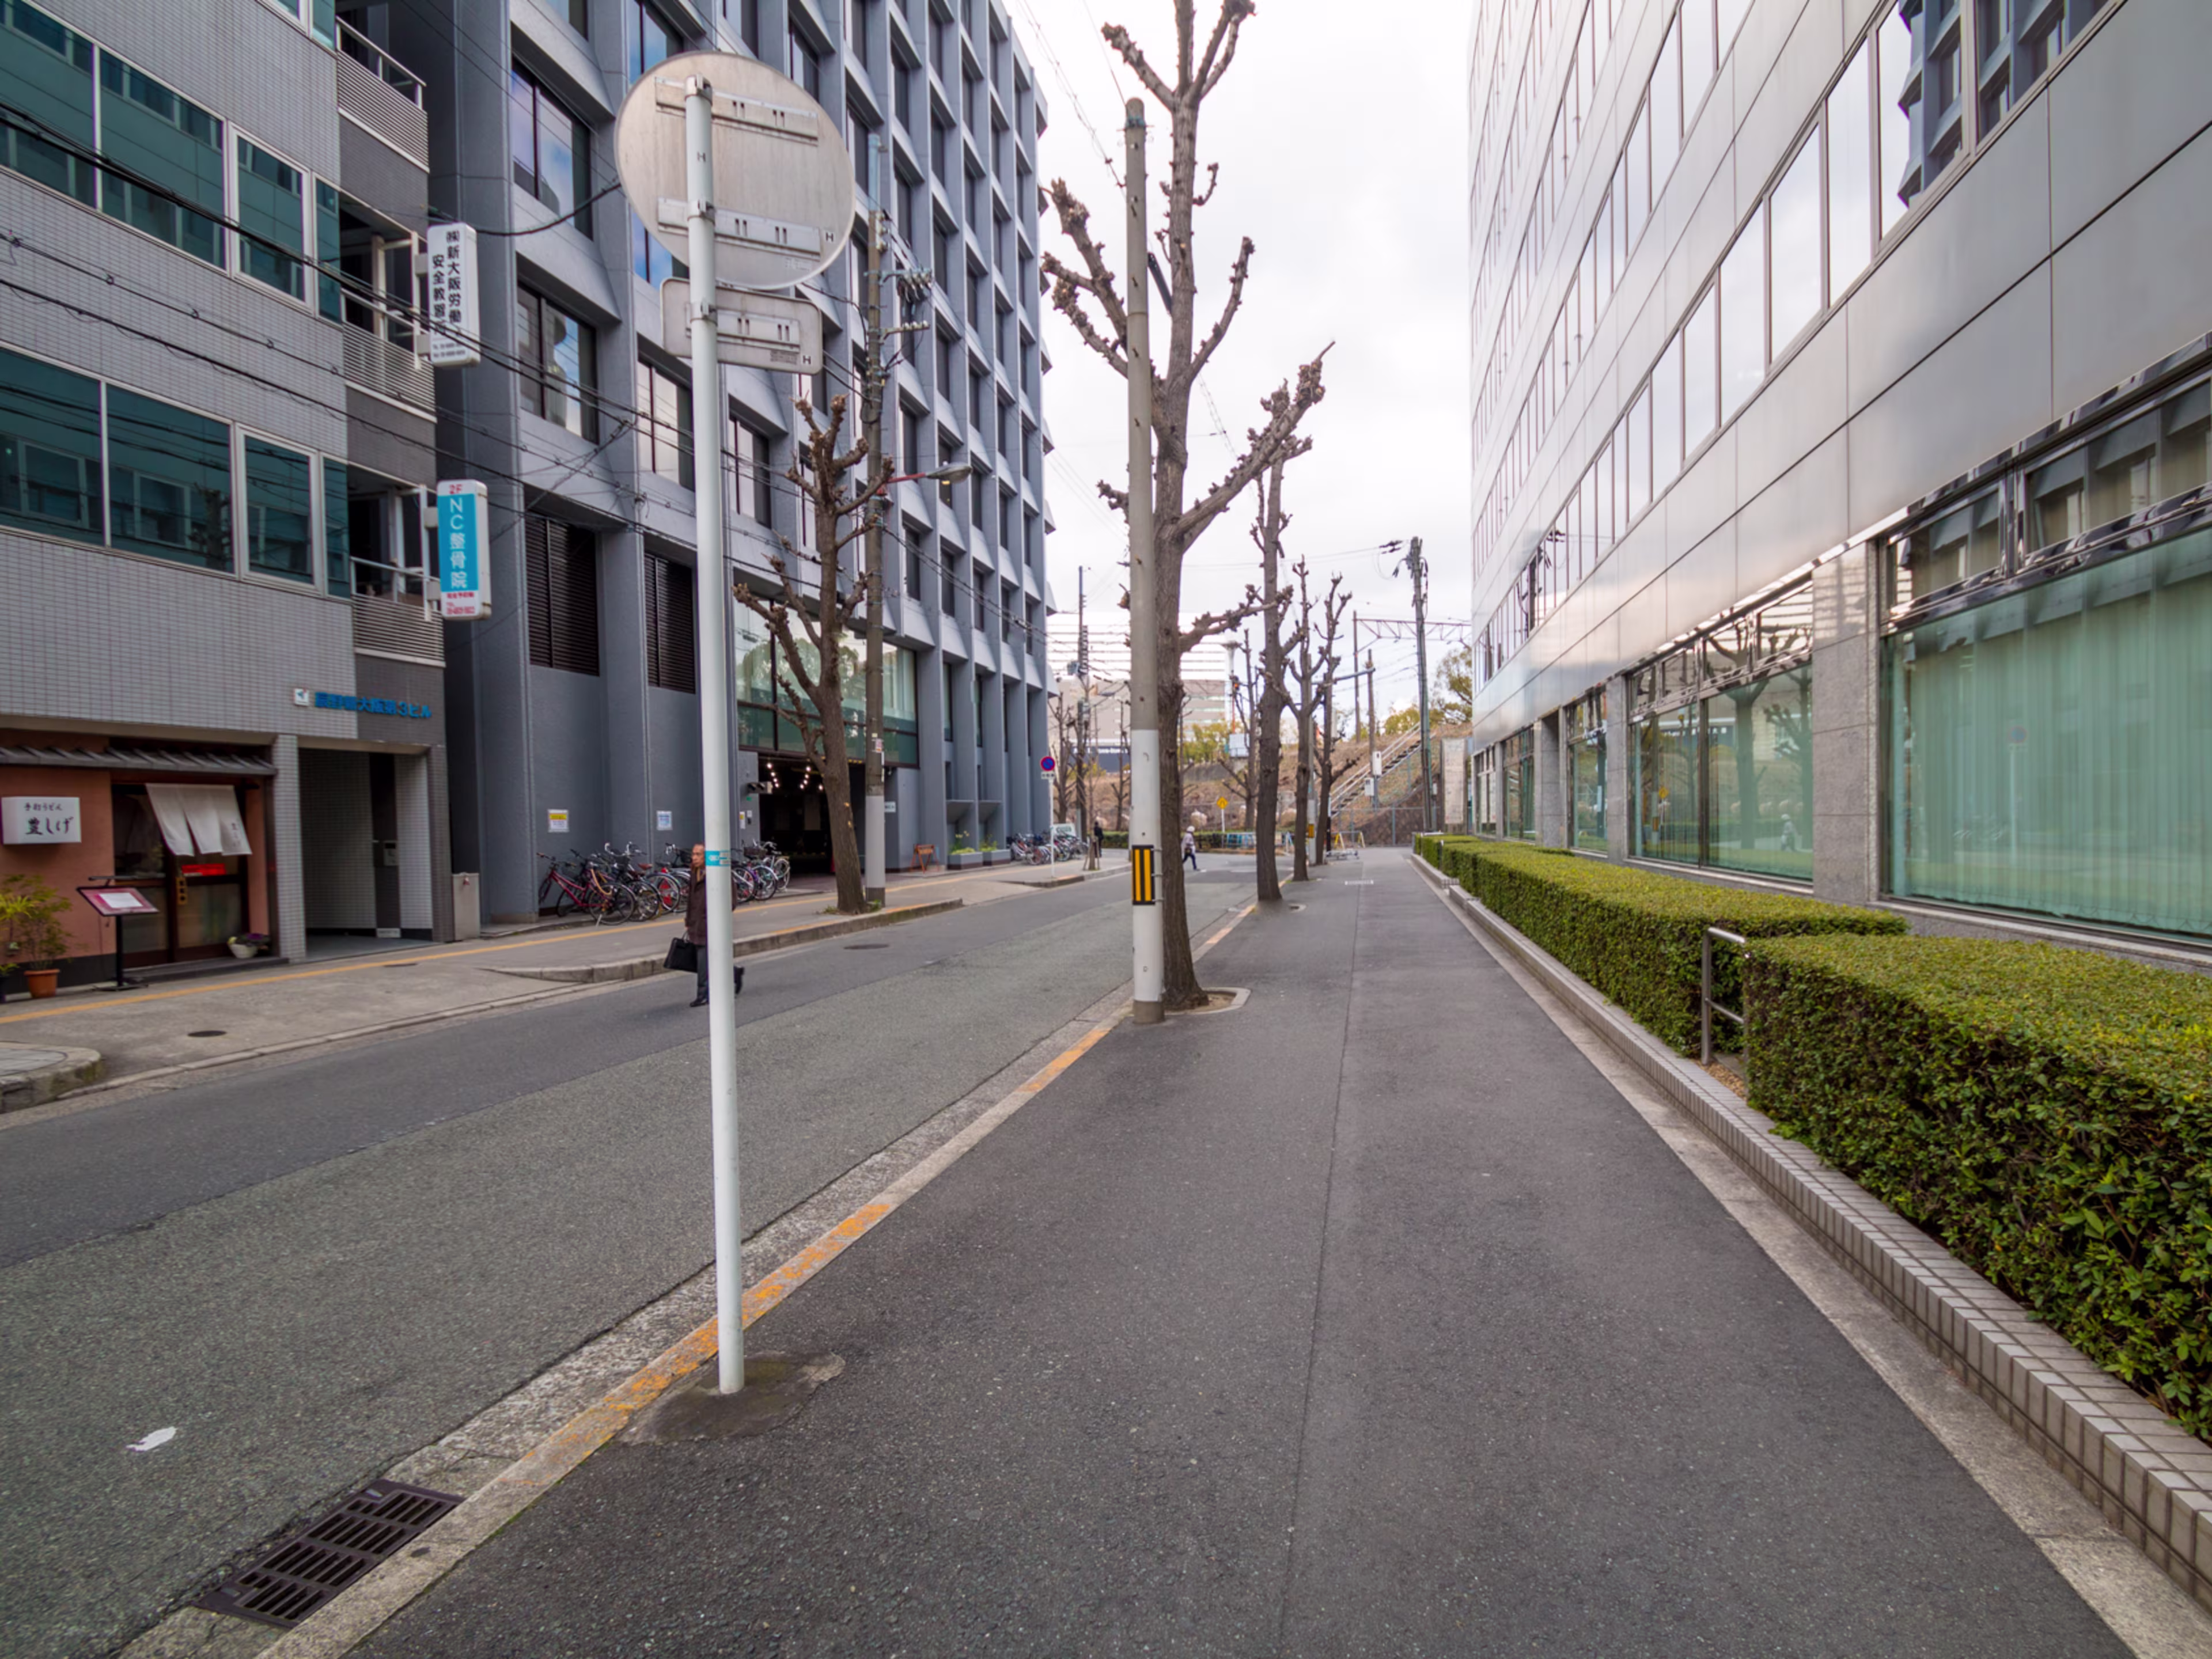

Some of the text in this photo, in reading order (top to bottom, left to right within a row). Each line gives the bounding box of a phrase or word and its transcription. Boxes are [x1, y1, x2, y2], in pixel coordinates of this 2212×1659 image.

[825, 232, 834, 243] H
[802, 355, 812, 365] H
[449, 484, 463, 495] 2F
